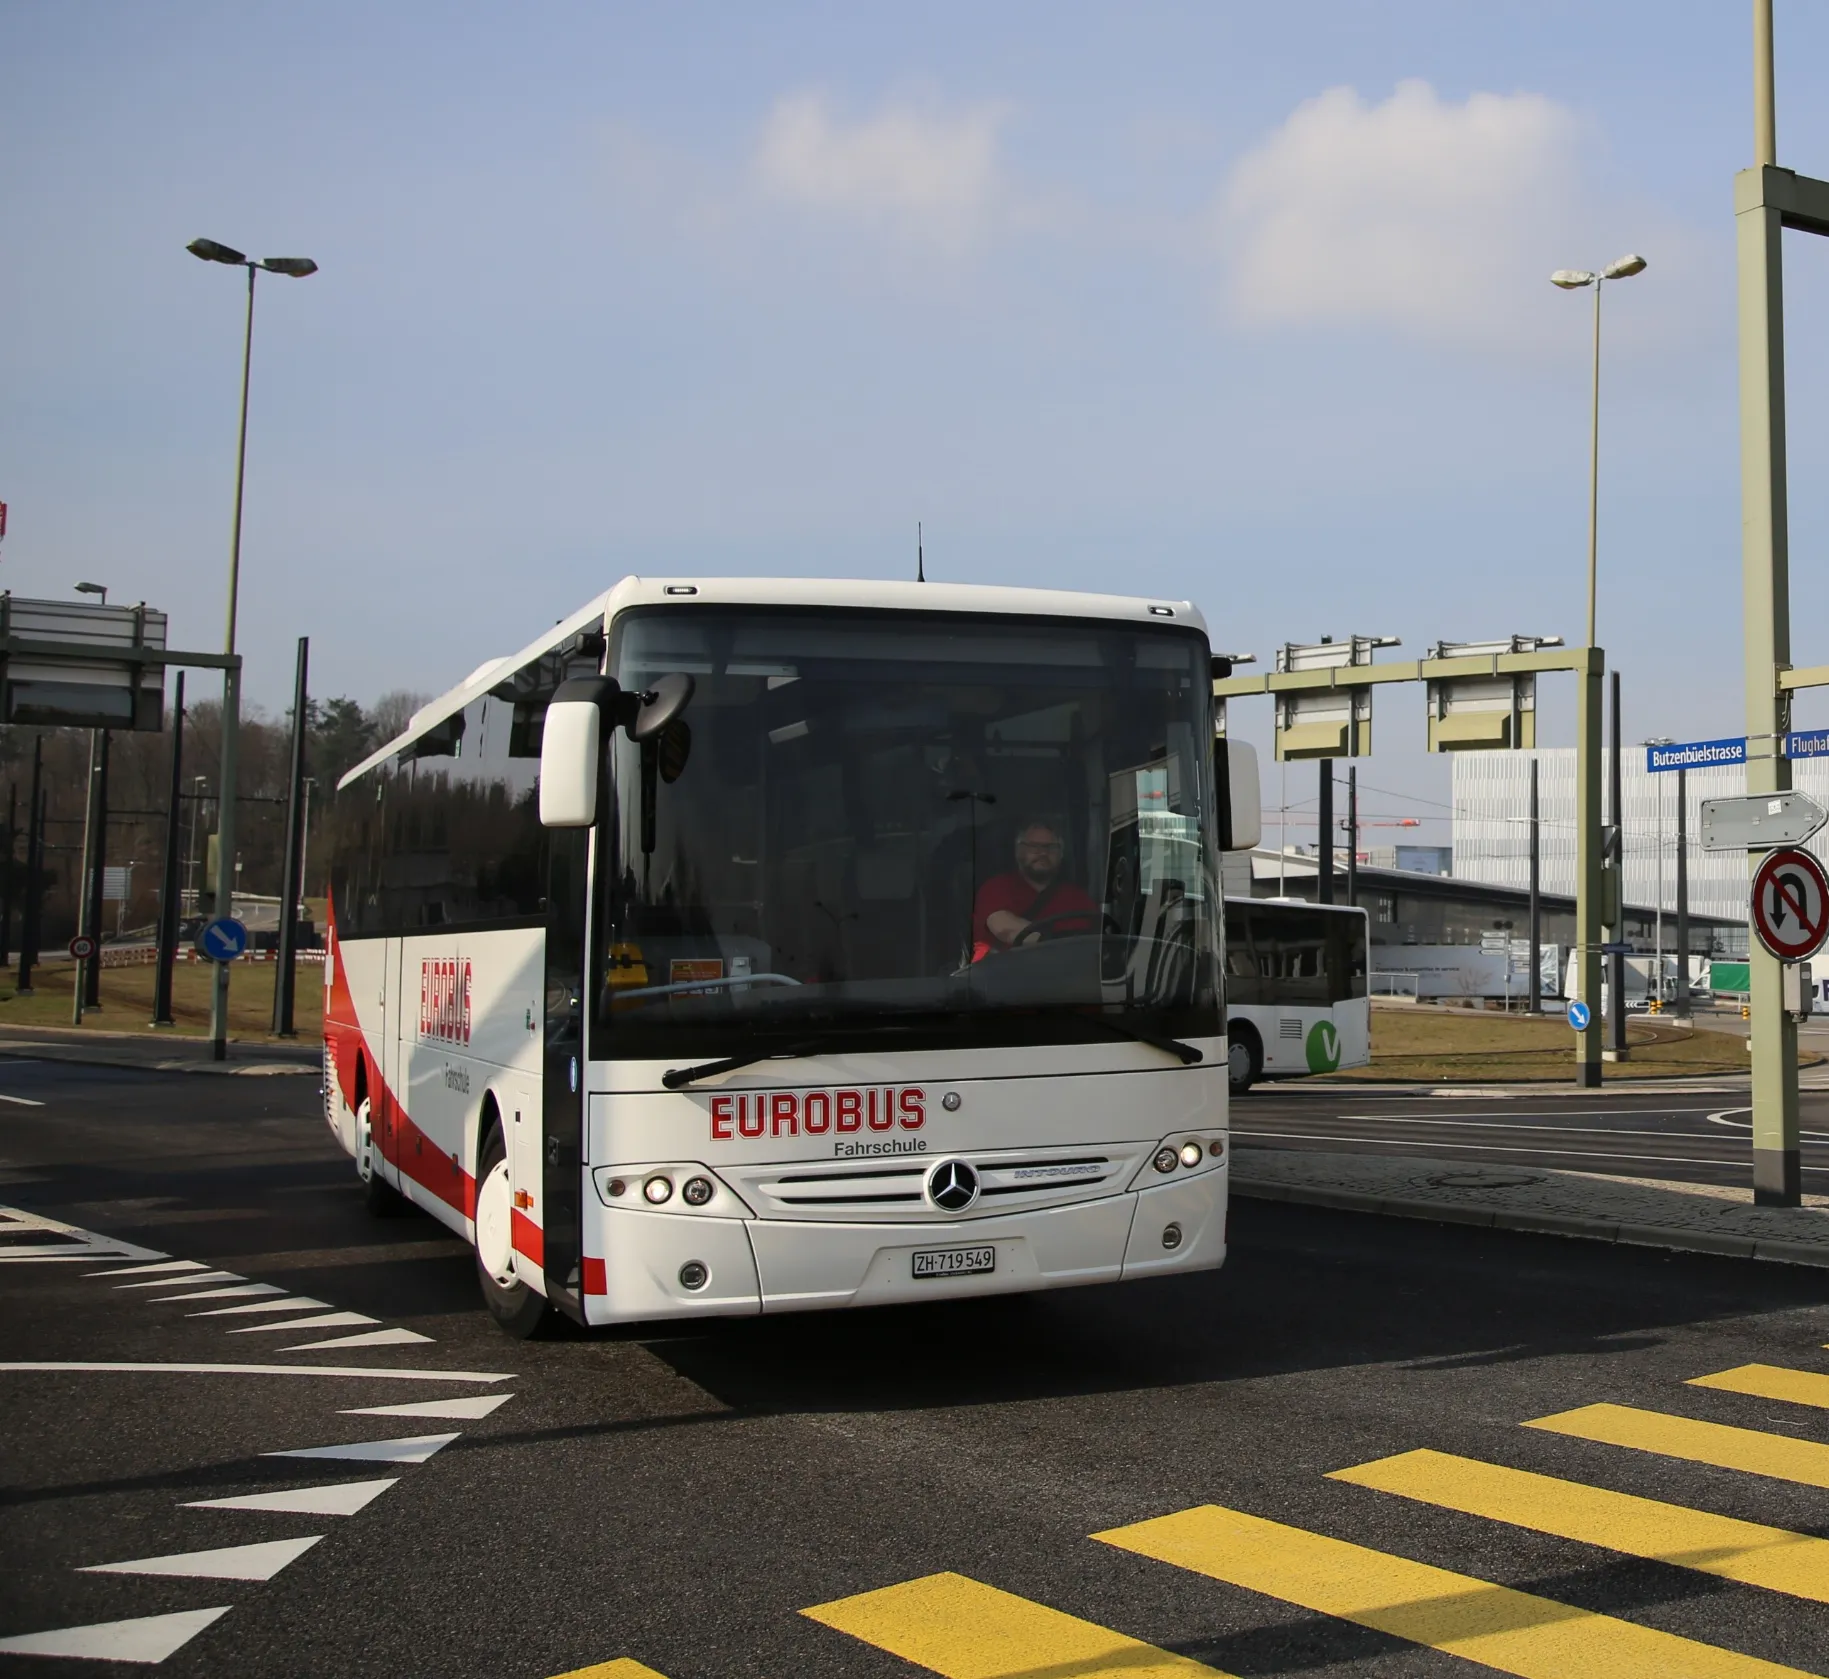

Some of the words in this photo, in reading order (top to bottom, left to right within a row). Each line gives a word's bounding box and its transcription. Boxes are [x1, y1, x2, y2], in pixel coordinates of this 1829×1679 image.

[1653, 745, 1742, 766] Butzenbüelstrasse
[420, 957, 471, 1047] EUROBUS
[445, 1061, 470, 1095] Fahrschule
[710, 1087, 926, 1140] EUROBUS
[834, 1138, 927, 1156] Fahrschule
[1014, 1165, 1100, 1178] INTOURO
